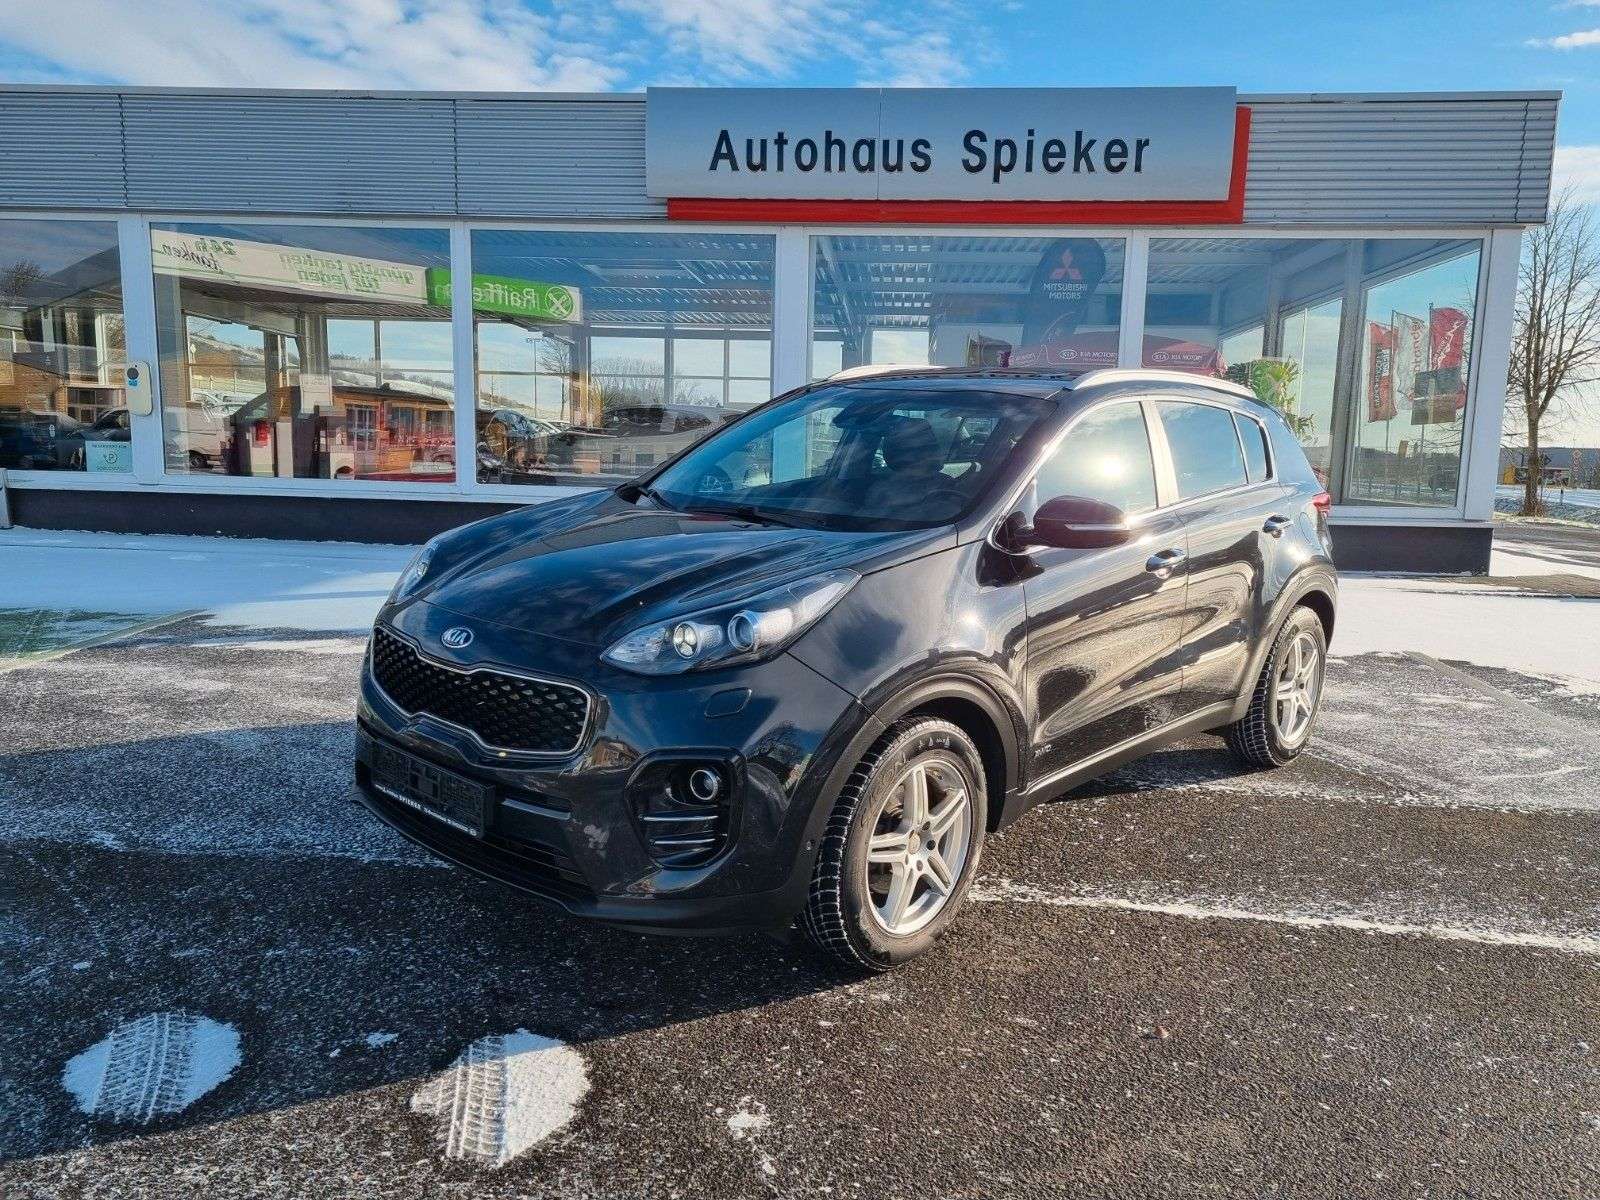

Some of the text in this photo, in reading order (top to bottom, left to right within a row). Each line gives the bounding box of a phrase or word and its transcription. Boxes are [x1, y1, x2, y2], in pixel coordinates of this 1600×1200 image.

[708, 128, 1150, 184] Autohaus Spieker
[1042, 282, 1088, 292] MITSUBISHI
[1048, 291, 1082, 300] MOTORS
[1092, 351, 1118, 359] MOTOR
[443, 629, 470, 646] KIA
